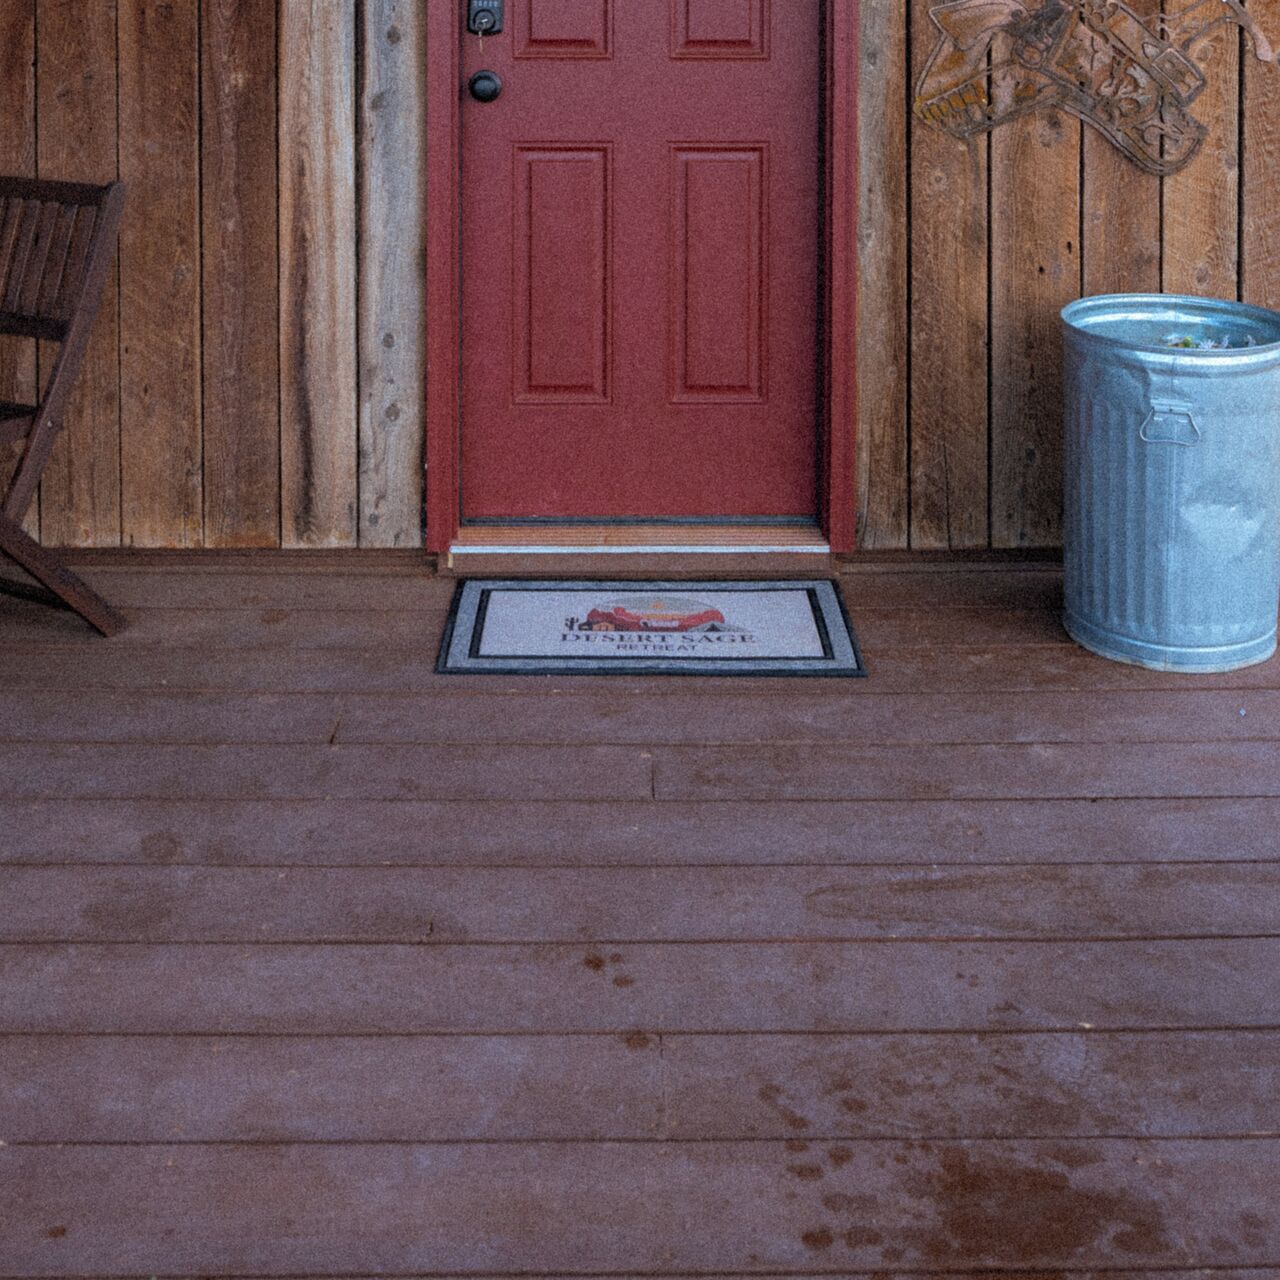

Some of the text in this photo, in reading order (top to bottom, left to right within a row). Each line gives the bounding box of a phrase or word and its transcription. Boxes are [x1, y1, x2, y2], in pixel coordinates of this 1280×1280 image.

[561, 633, 757, 644] DESERT SAGE
[616, 643, 698, 652] RETREAT
